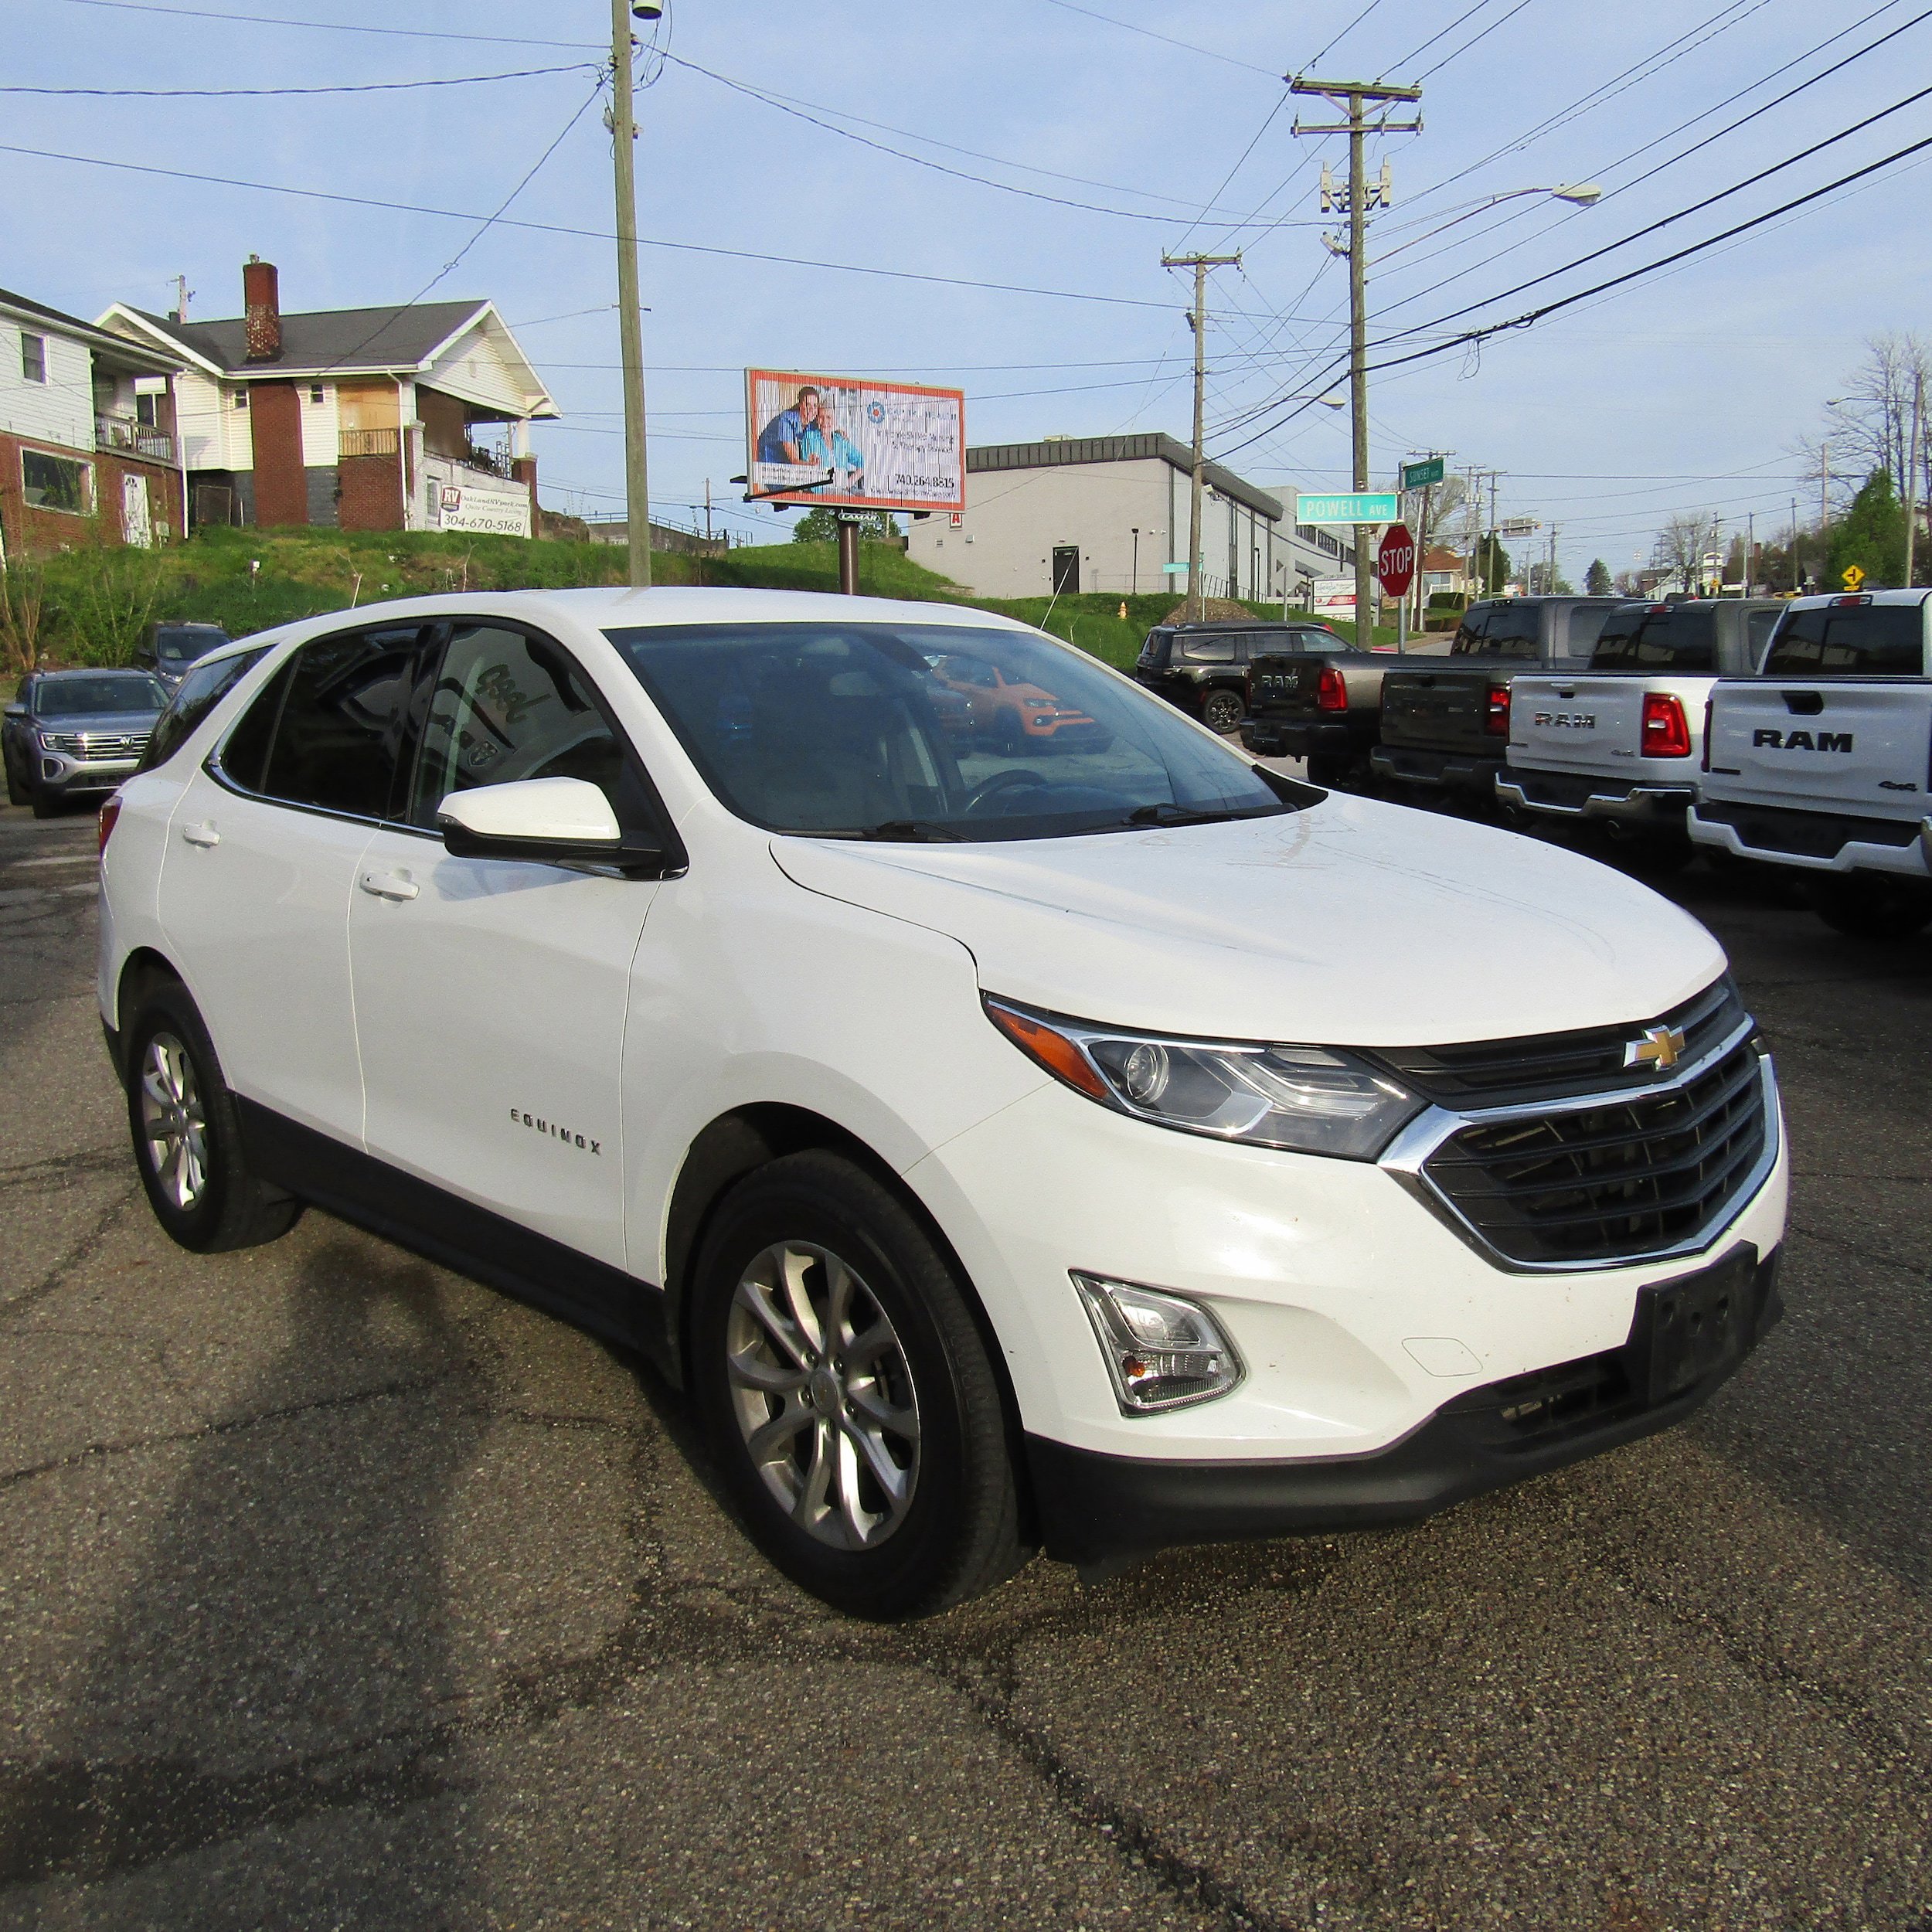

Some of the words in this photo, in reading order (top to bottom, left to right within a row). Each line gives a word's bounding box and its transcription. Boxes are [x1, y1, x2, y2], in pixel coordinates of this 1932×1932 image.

[1410, 467, 1430, 483] SUNSET
[444, 488, 459, 503] RV
[1306, 500, 1363, 517] POWELL
[1369, 504, 1388, 516] AVE
[444, 514, 522, 532] 304-670-5168
[1381, 546, 1413, 577] STOP
[1261, 675, 1299, 689] RAM
[1535, 711, 1595, 728] RAM
[1753, 729, 1852, 753] RAM
[511, 1108, 600, 1156] EQUINOX
